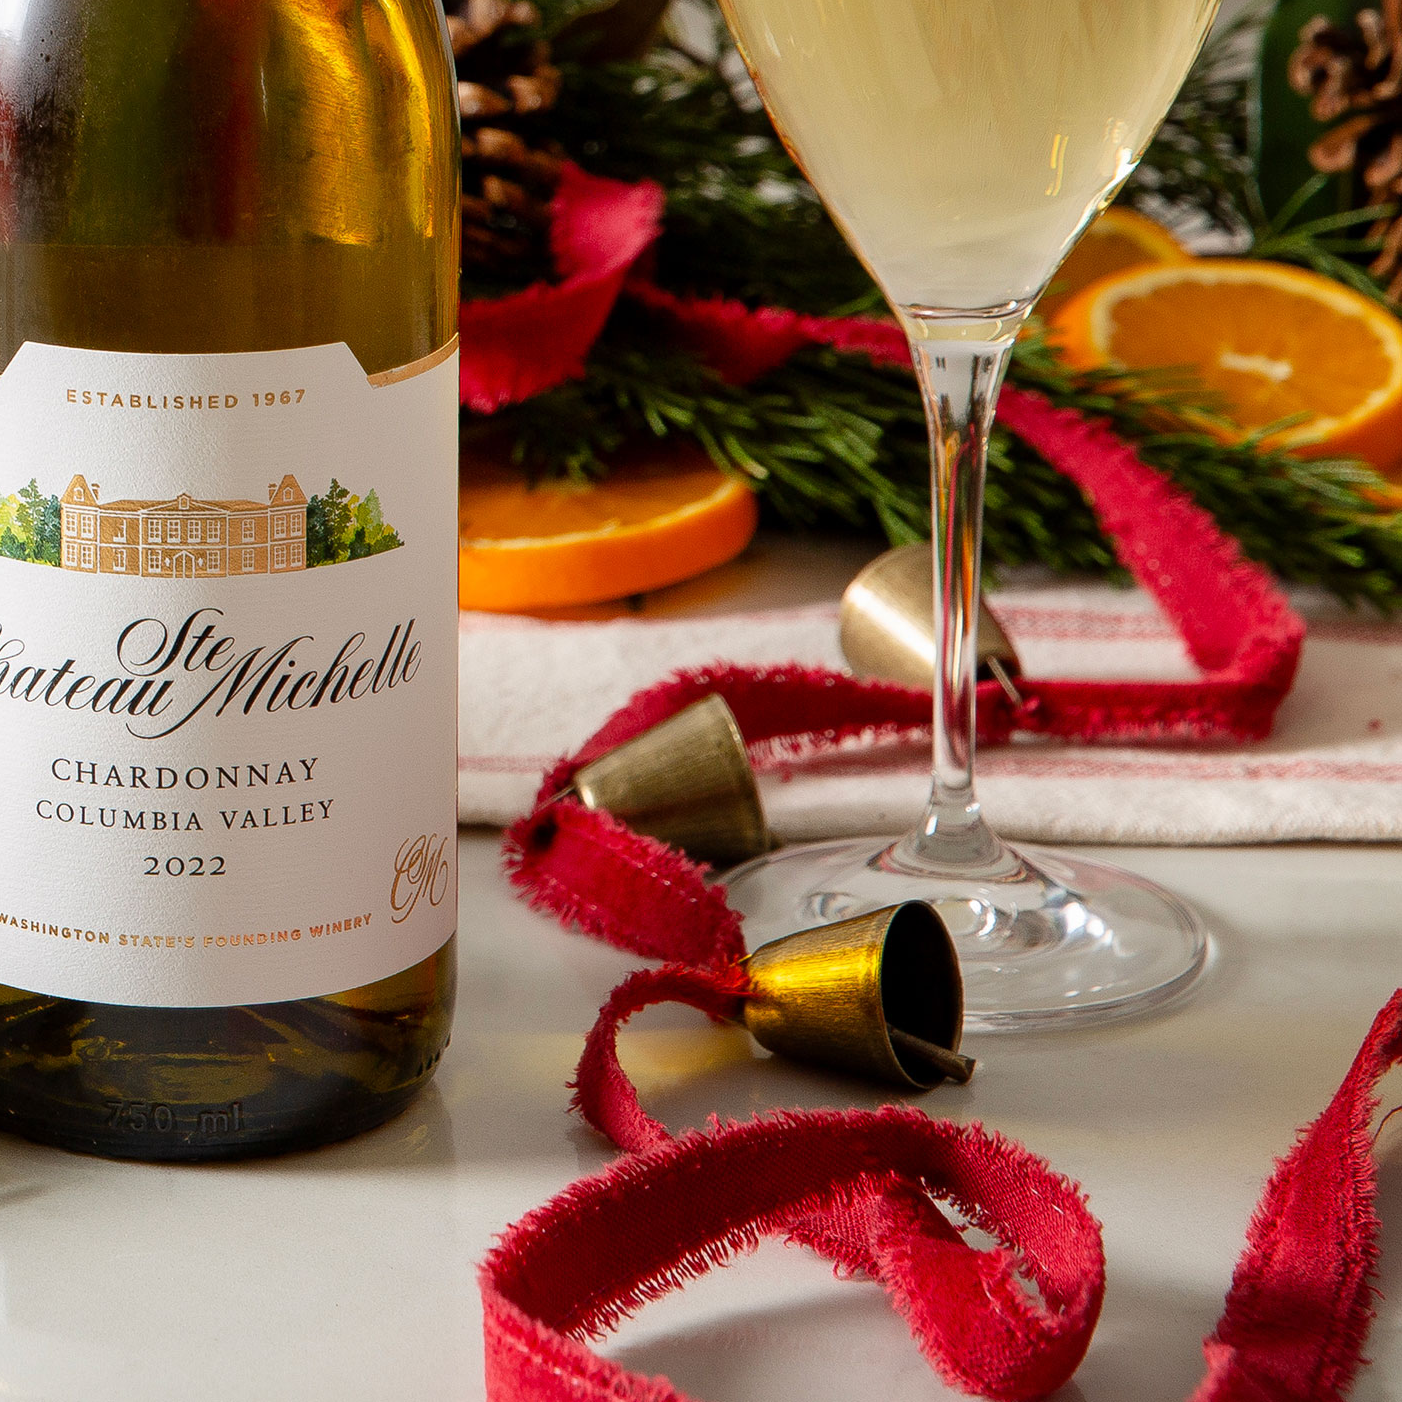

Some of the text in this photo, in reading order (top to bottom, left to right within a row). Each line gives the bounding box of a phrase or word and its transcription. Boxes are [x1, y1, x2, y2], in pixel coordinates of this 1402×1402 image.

[66, 388, 306, 411] ESTABLISHED 1967
[116, 607, 237, 677] Ste
[125, 617, 422, 740] Michelle
[51, 757, 319, 791] CHARDONNAY
[36, 798, 335, 832] COLUMBIA VALLEY
[143, 855, 227, 878] 2022
[118, 933, 196, 949] STATE'S
[203, 928, 302, 949] FOUNDING
[309, 912, 373, 939] WINERY
[106, 1100, 246, 1134] 750 ml
